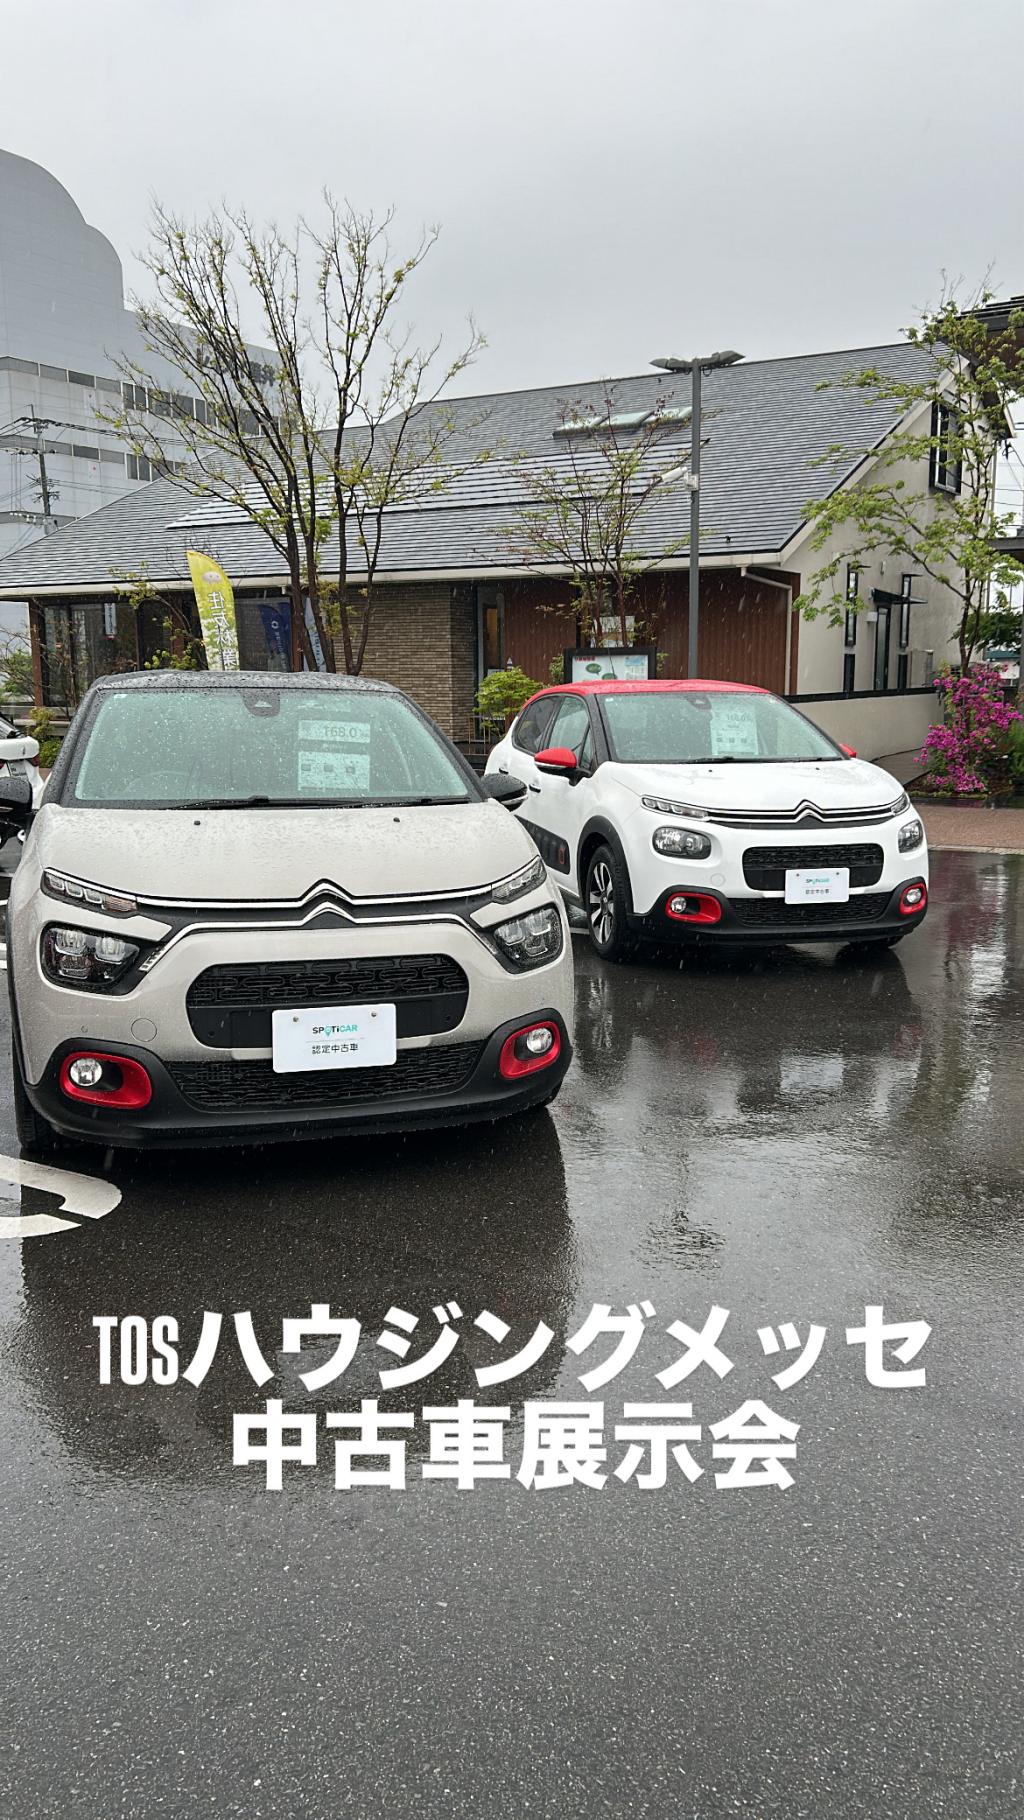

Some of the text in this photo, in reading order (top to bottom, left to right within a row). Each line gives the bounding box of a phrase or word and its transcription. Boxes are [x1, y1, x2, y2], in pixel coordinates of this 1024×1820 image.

[312, 1043, 358, 1055] 認定中古車
